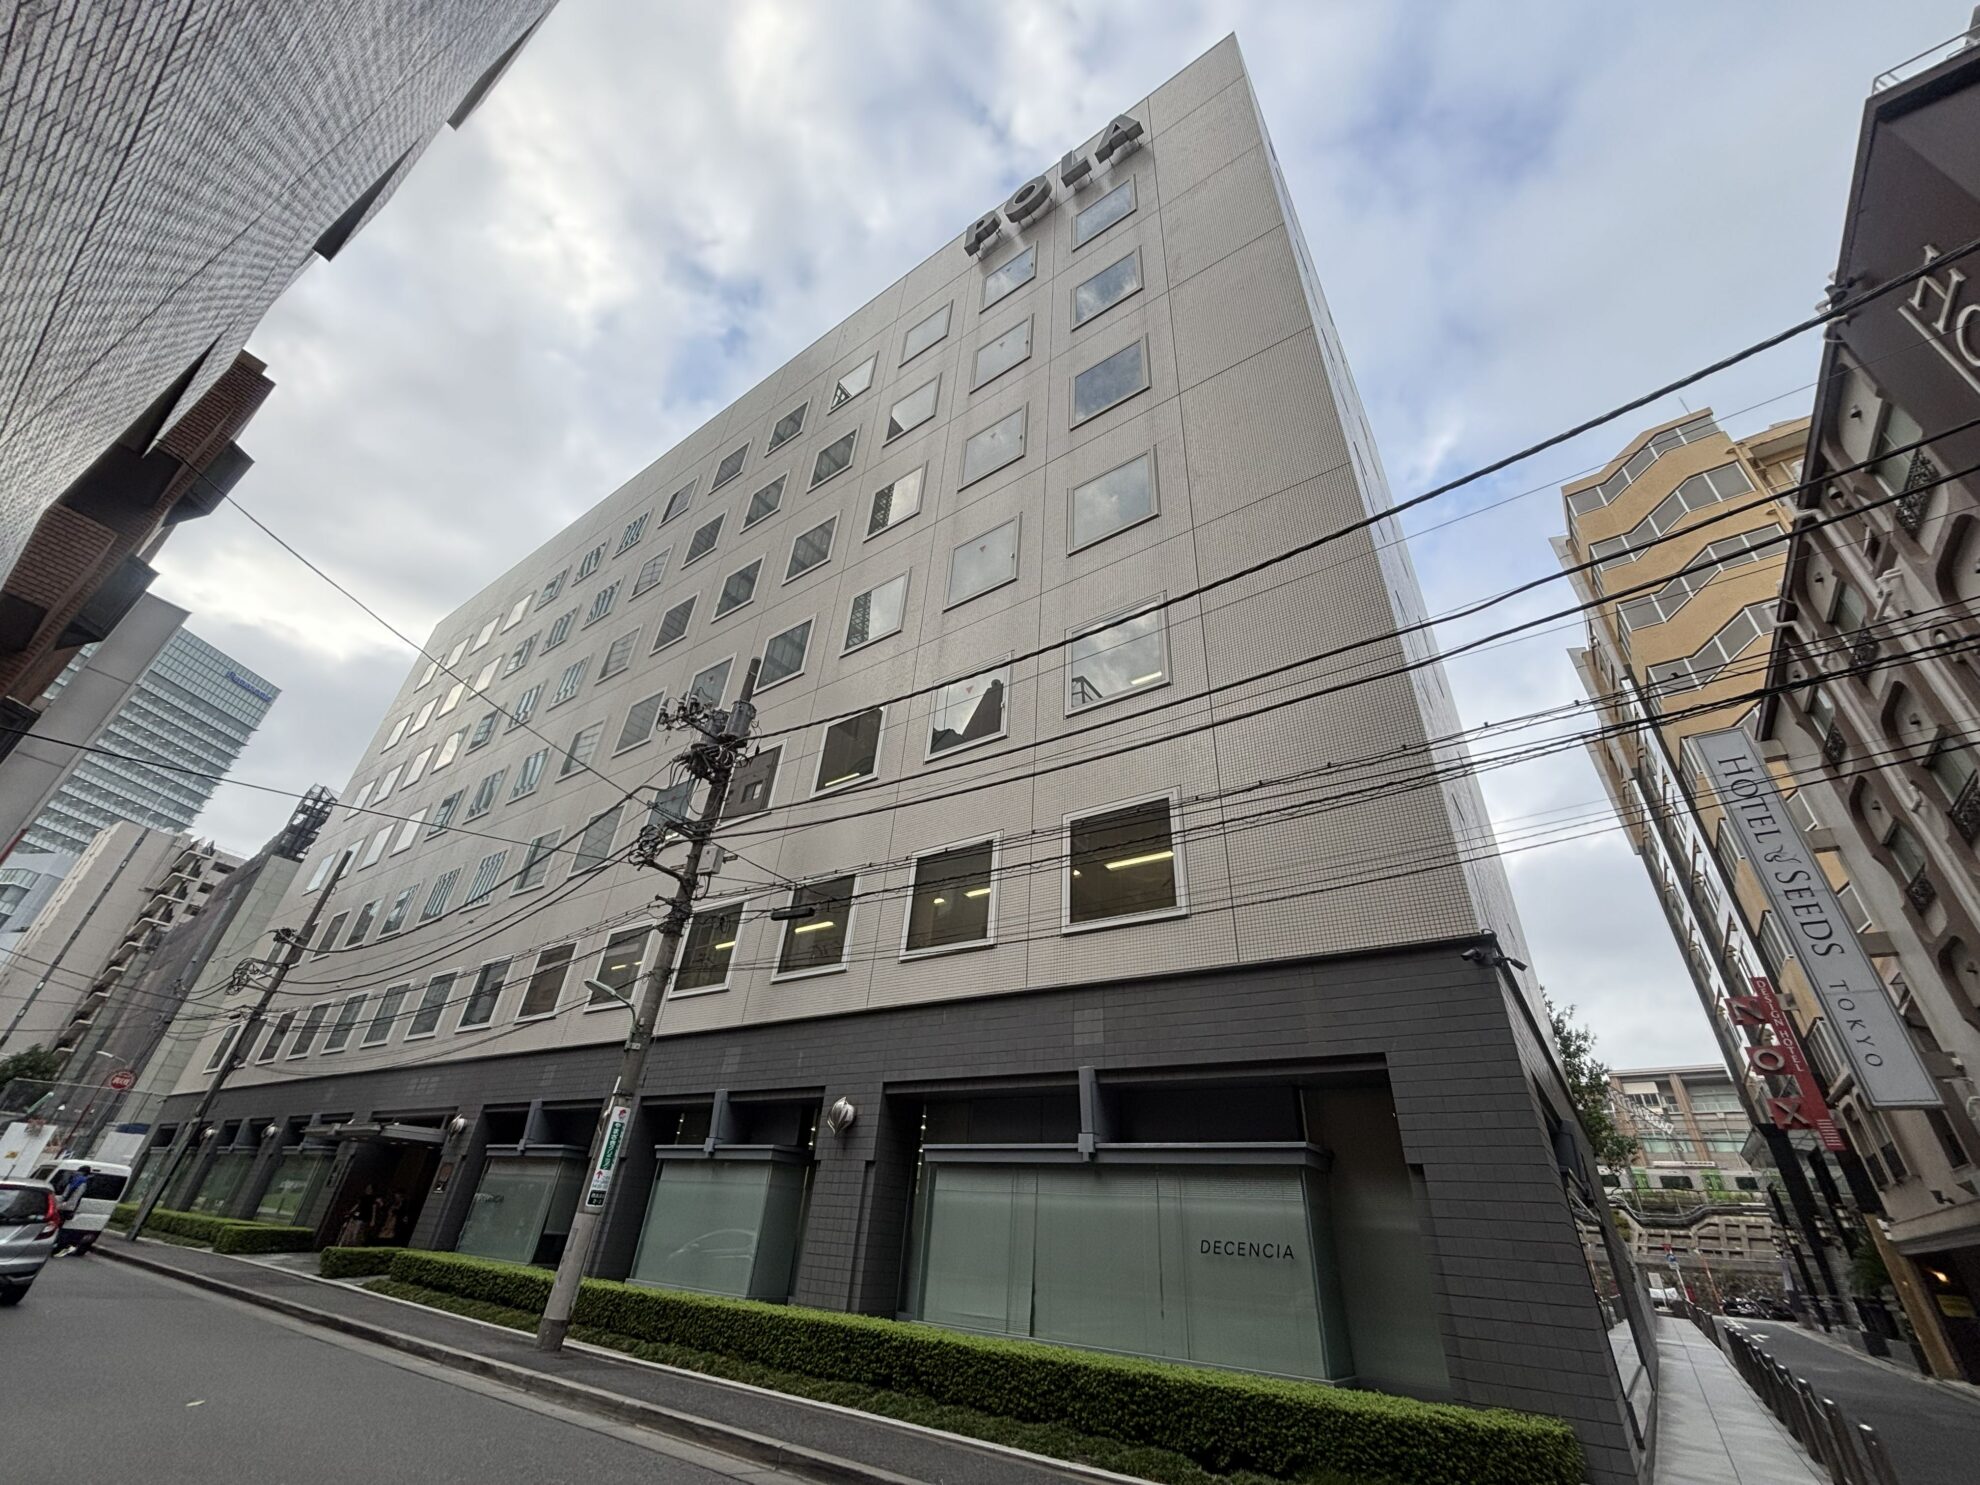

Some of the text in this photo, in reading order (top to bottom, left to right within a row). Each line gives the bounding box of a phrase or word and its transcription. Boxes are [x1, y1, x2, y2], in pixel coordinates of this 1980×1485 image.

[963, 114, 1144, 257] POLA
[1718, 754, 1883, 1067] HOTEL SEEDS TOKYO
[1731, 1000, 1813, 1125] NOX
[1756, 980, 1804, 1072] DESIGN HOTEL
[1200, 1240, 1295, 1260] DECENCIA
